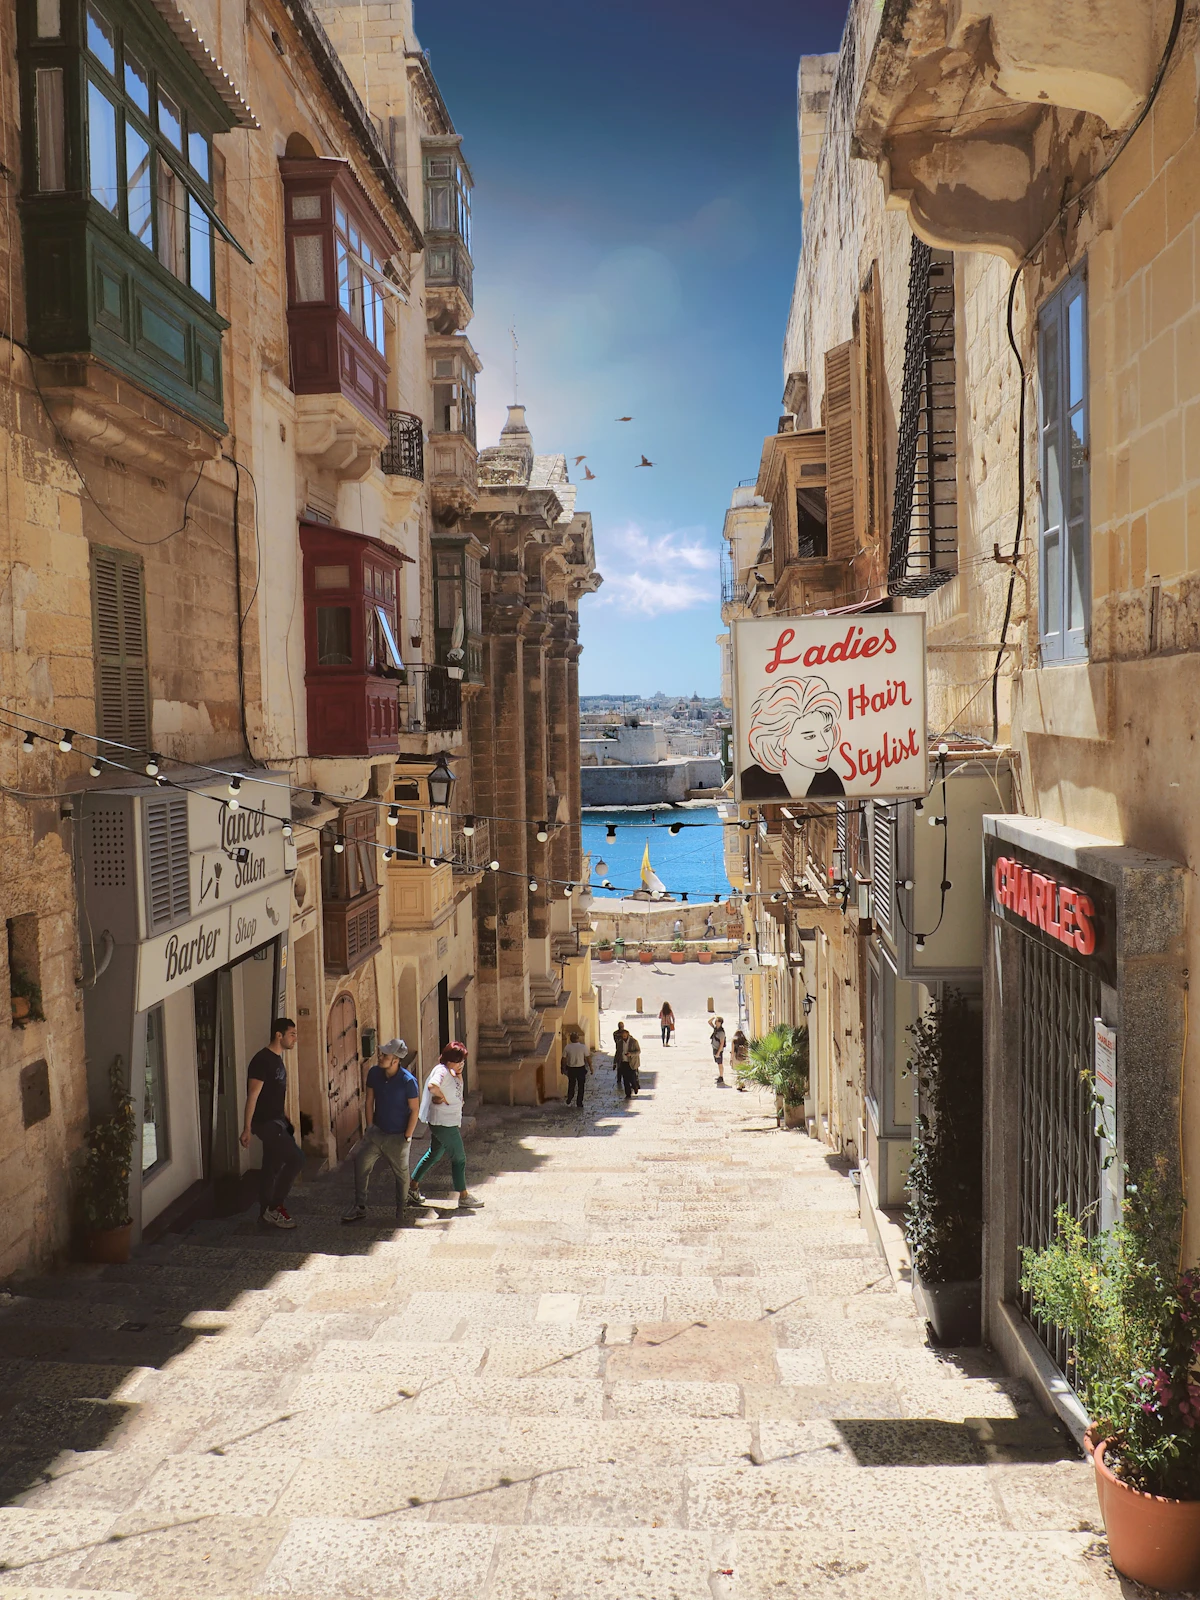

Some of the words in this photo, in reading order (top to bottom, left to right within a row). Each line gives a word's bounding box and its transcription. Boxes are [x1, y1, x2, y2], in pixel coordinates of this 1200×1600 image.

[764, 626, 897, 674] Ladies
[848, 679, 912, 720] Hair
[839, 727, 920, 787] Stylist
[234, 852, 266, 888] Salon
[994, 856, 1096, 955] CHARLES
[165, 924, 221, 982] Barber
[235, 917, 257, 945] Shop
